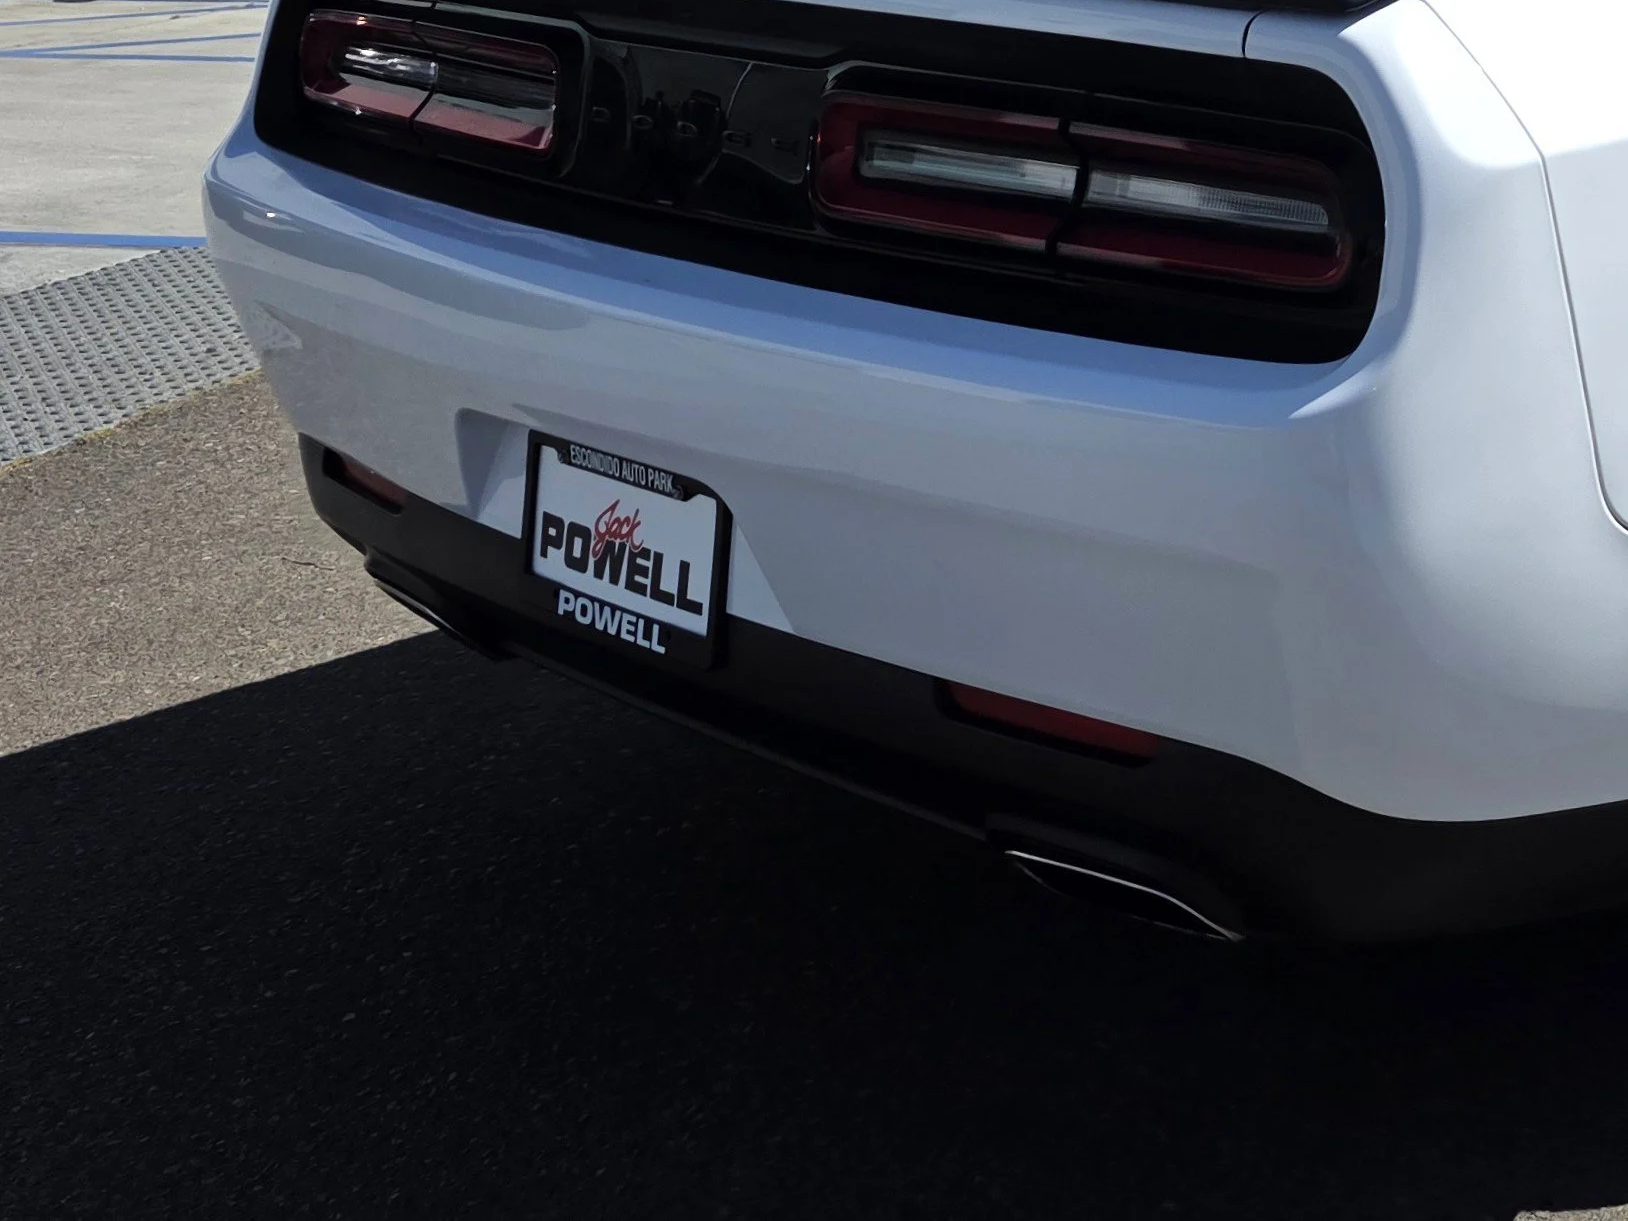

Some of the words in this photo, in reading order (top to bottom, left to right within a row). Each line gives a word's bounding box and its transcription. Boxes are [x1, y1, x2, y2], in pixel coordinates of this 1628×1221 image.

[569, 443, 620, 478] ESCONDIDO
[621, 460, 647, 486] AUTO
[648, 468, 674, 493] PARK
[591, 498, 644, 559] Jack
[540, 510, 704, 617] POWELL
[557, 588, 666, 655] POWELL
